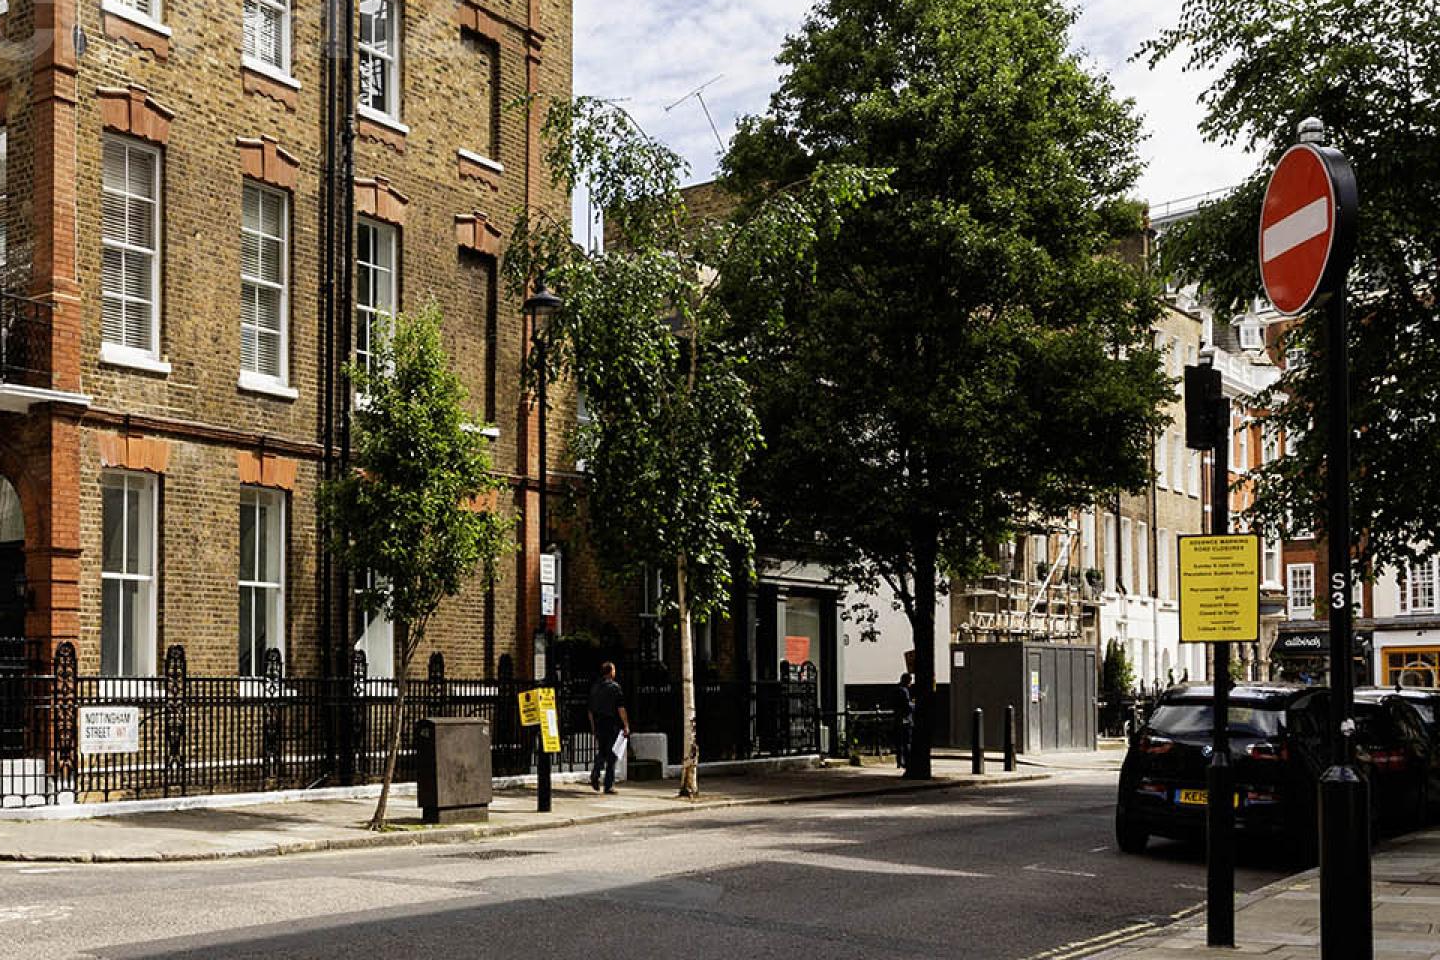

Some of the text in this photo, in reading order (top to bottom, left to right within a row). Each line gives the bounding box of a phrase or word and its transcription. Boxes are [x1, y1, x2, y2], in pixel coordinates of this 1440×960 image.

[1332, 572, 1345, 590] S
[1332, 591, 1345, 609] 3
[85, 711, 131, 724] NOTTINGHAM
[85, 725, 111, 739] STREET
